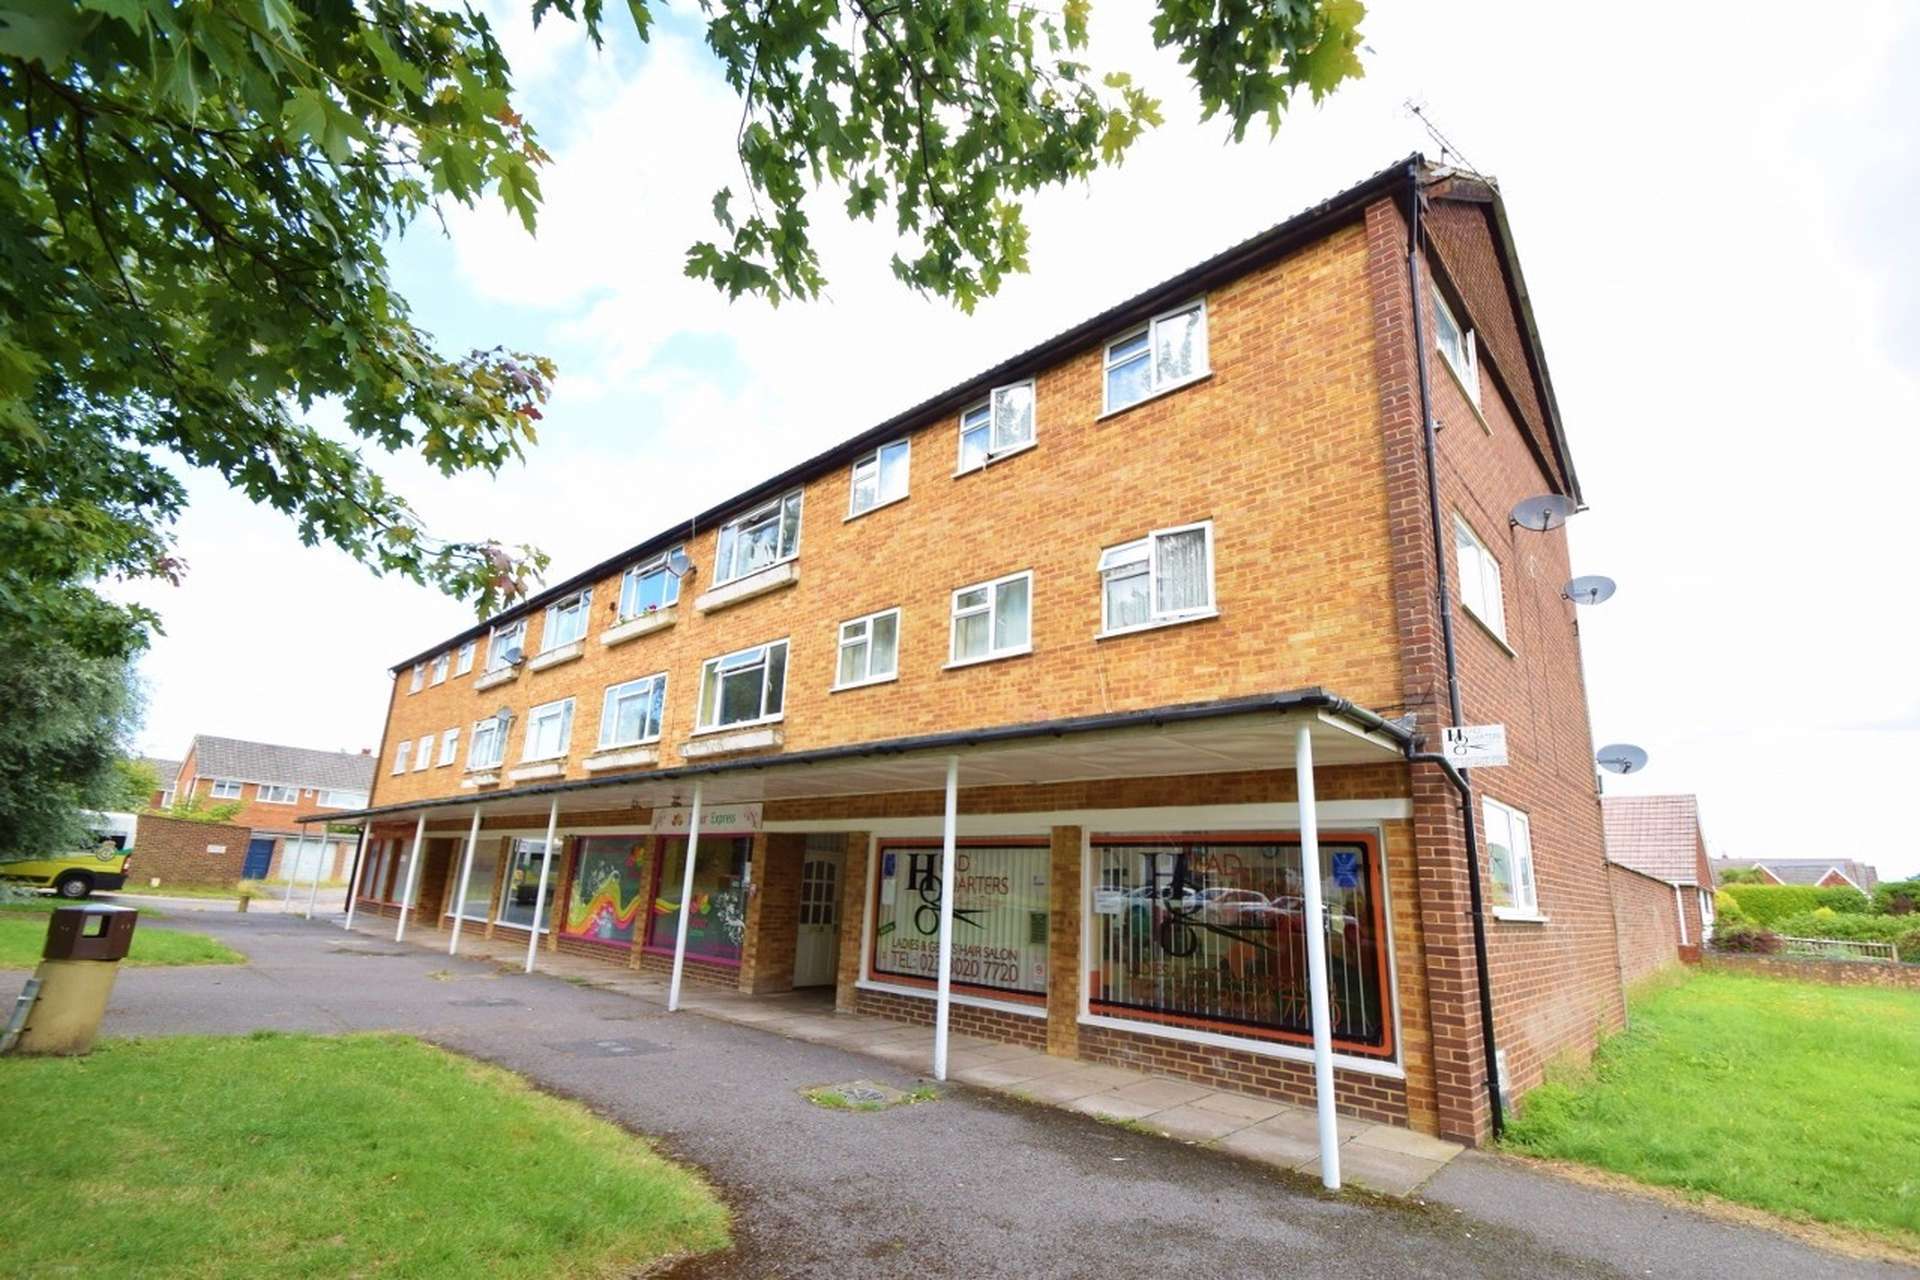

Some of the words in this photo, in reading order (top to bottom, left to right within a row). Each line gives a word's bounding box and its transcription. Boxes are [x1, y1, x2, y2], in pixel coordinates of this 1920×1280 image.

[891, 937, 920, 952] LADIES
[983, 946, 1018, 961] SALON
[984, 961, 1019, 983] 7720
